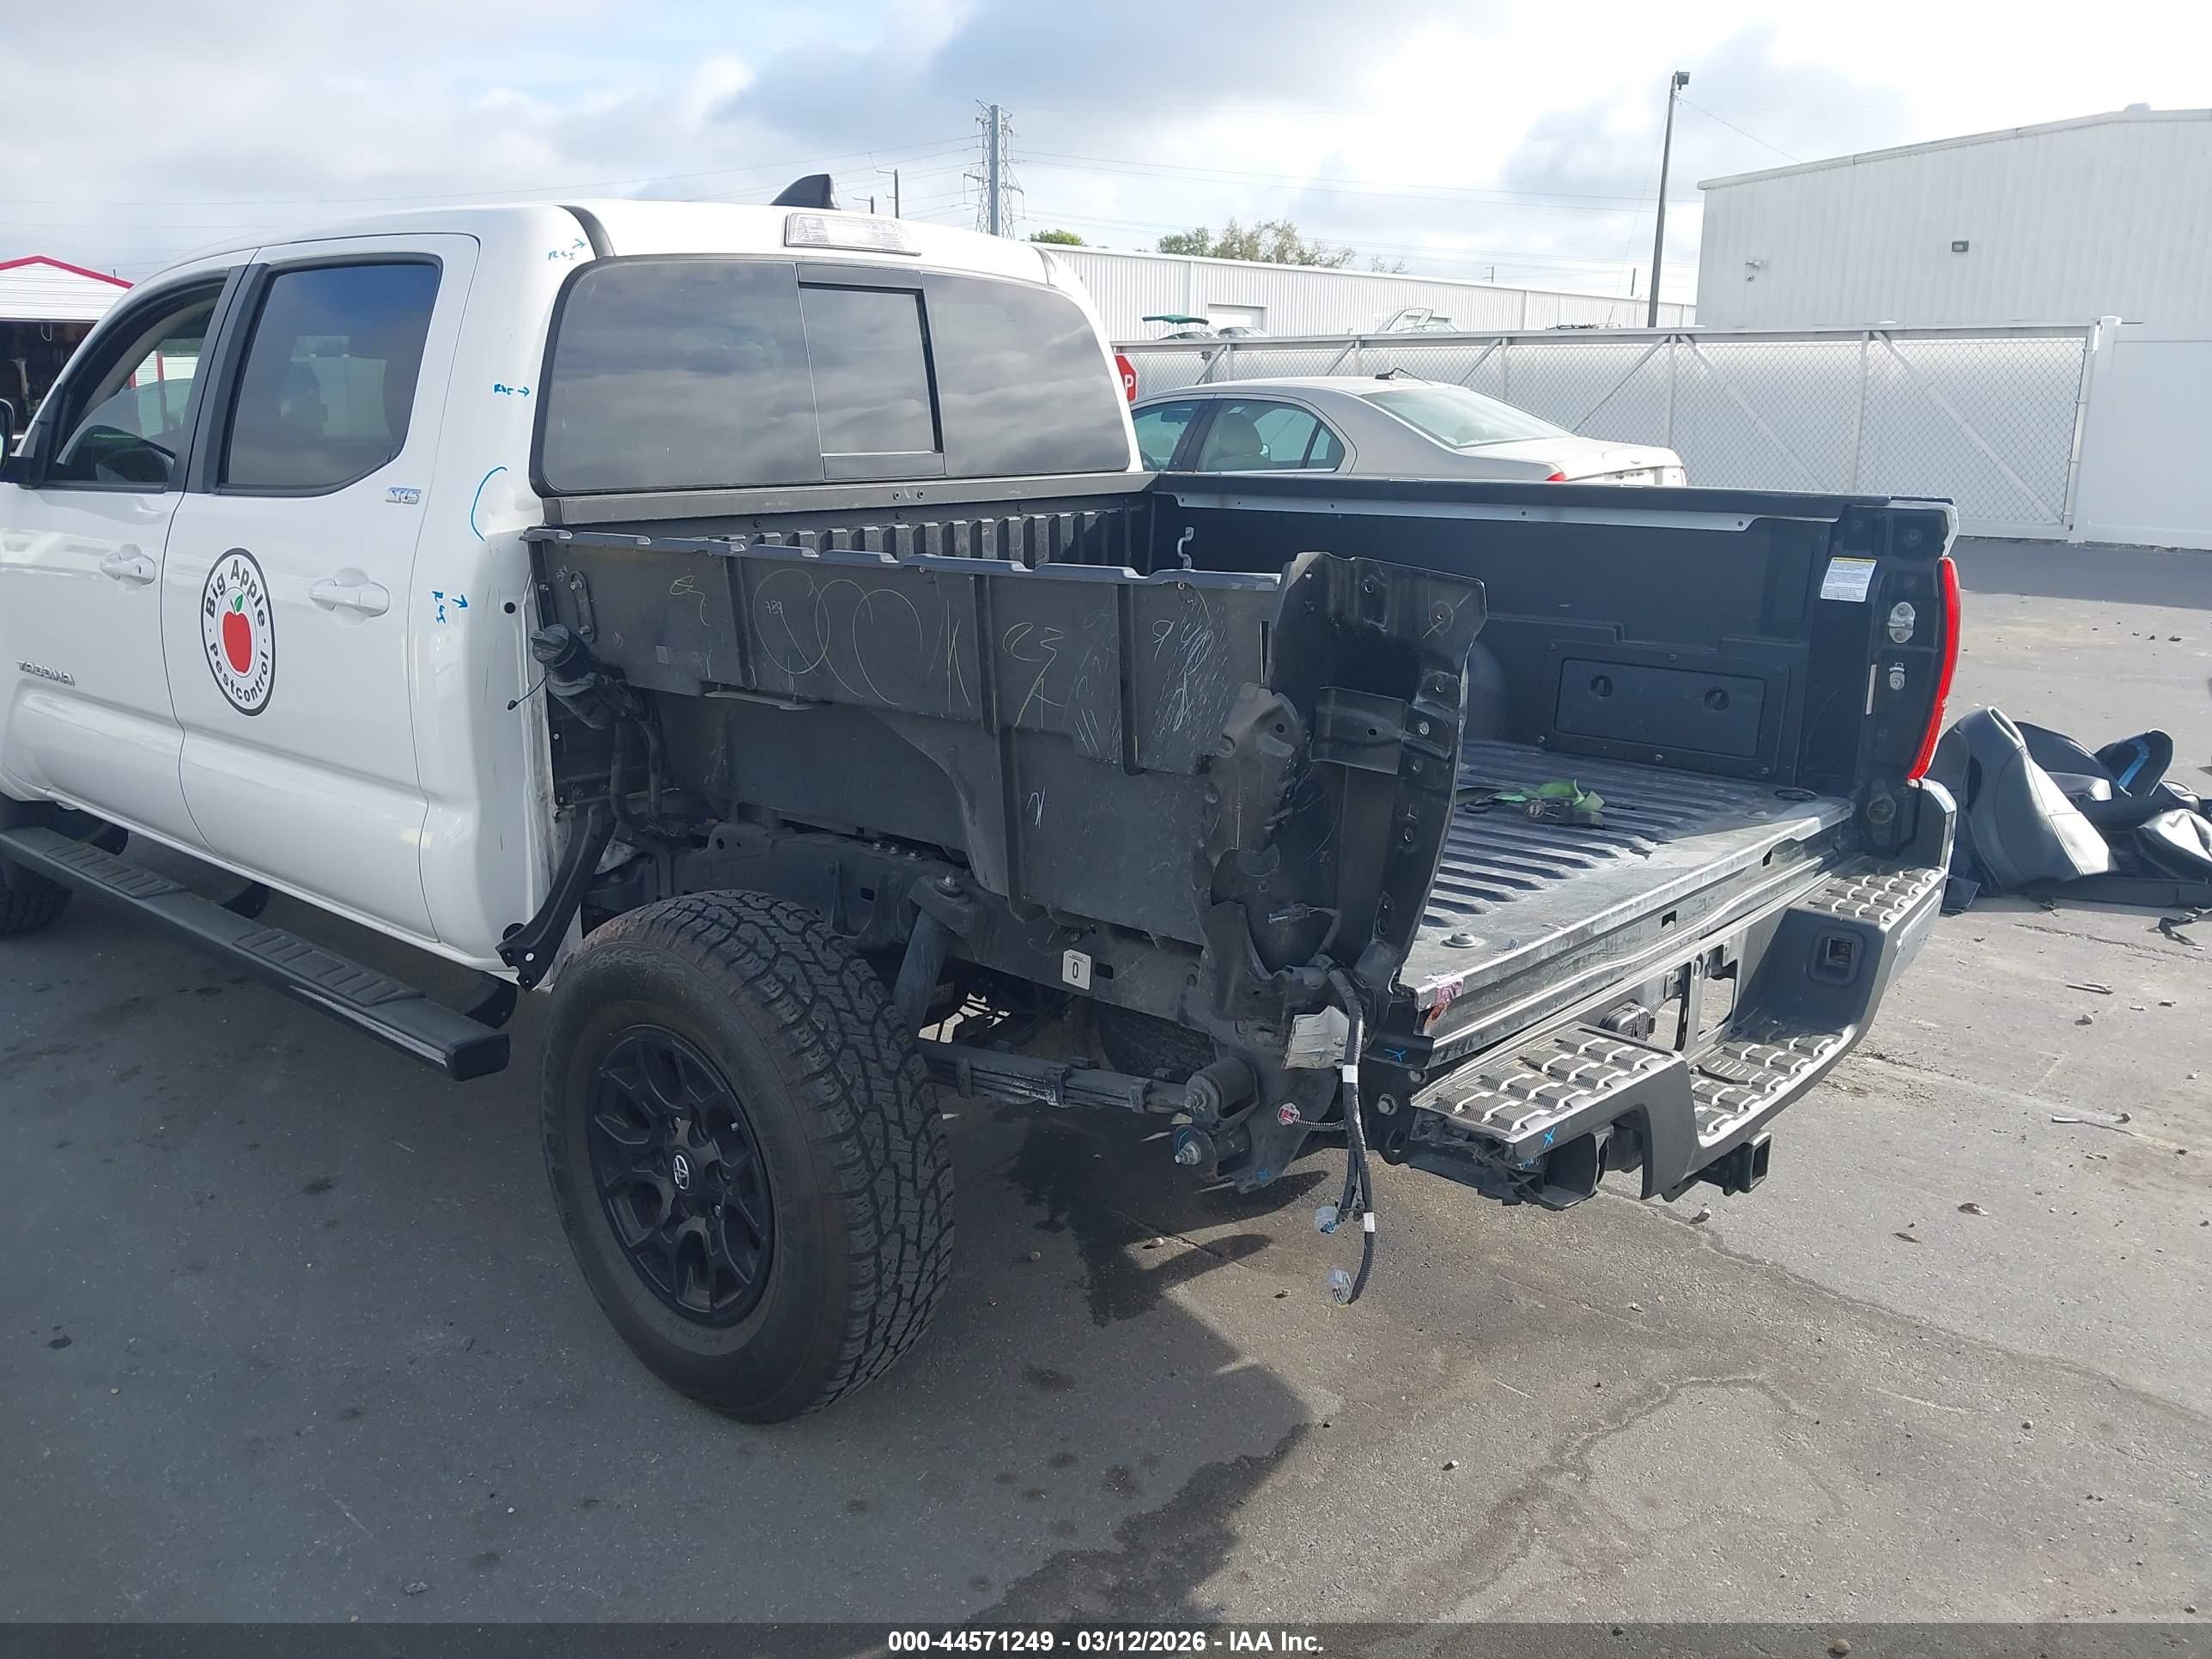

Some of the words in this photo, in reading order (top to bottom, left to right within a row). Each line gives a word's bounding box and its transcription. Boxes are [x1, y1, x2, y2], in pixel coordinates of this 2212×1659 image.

[205, 573, 226, 618] Big
[230, 559, 265, 627] Apple
[15, 659, 76, 687] TACOMA
